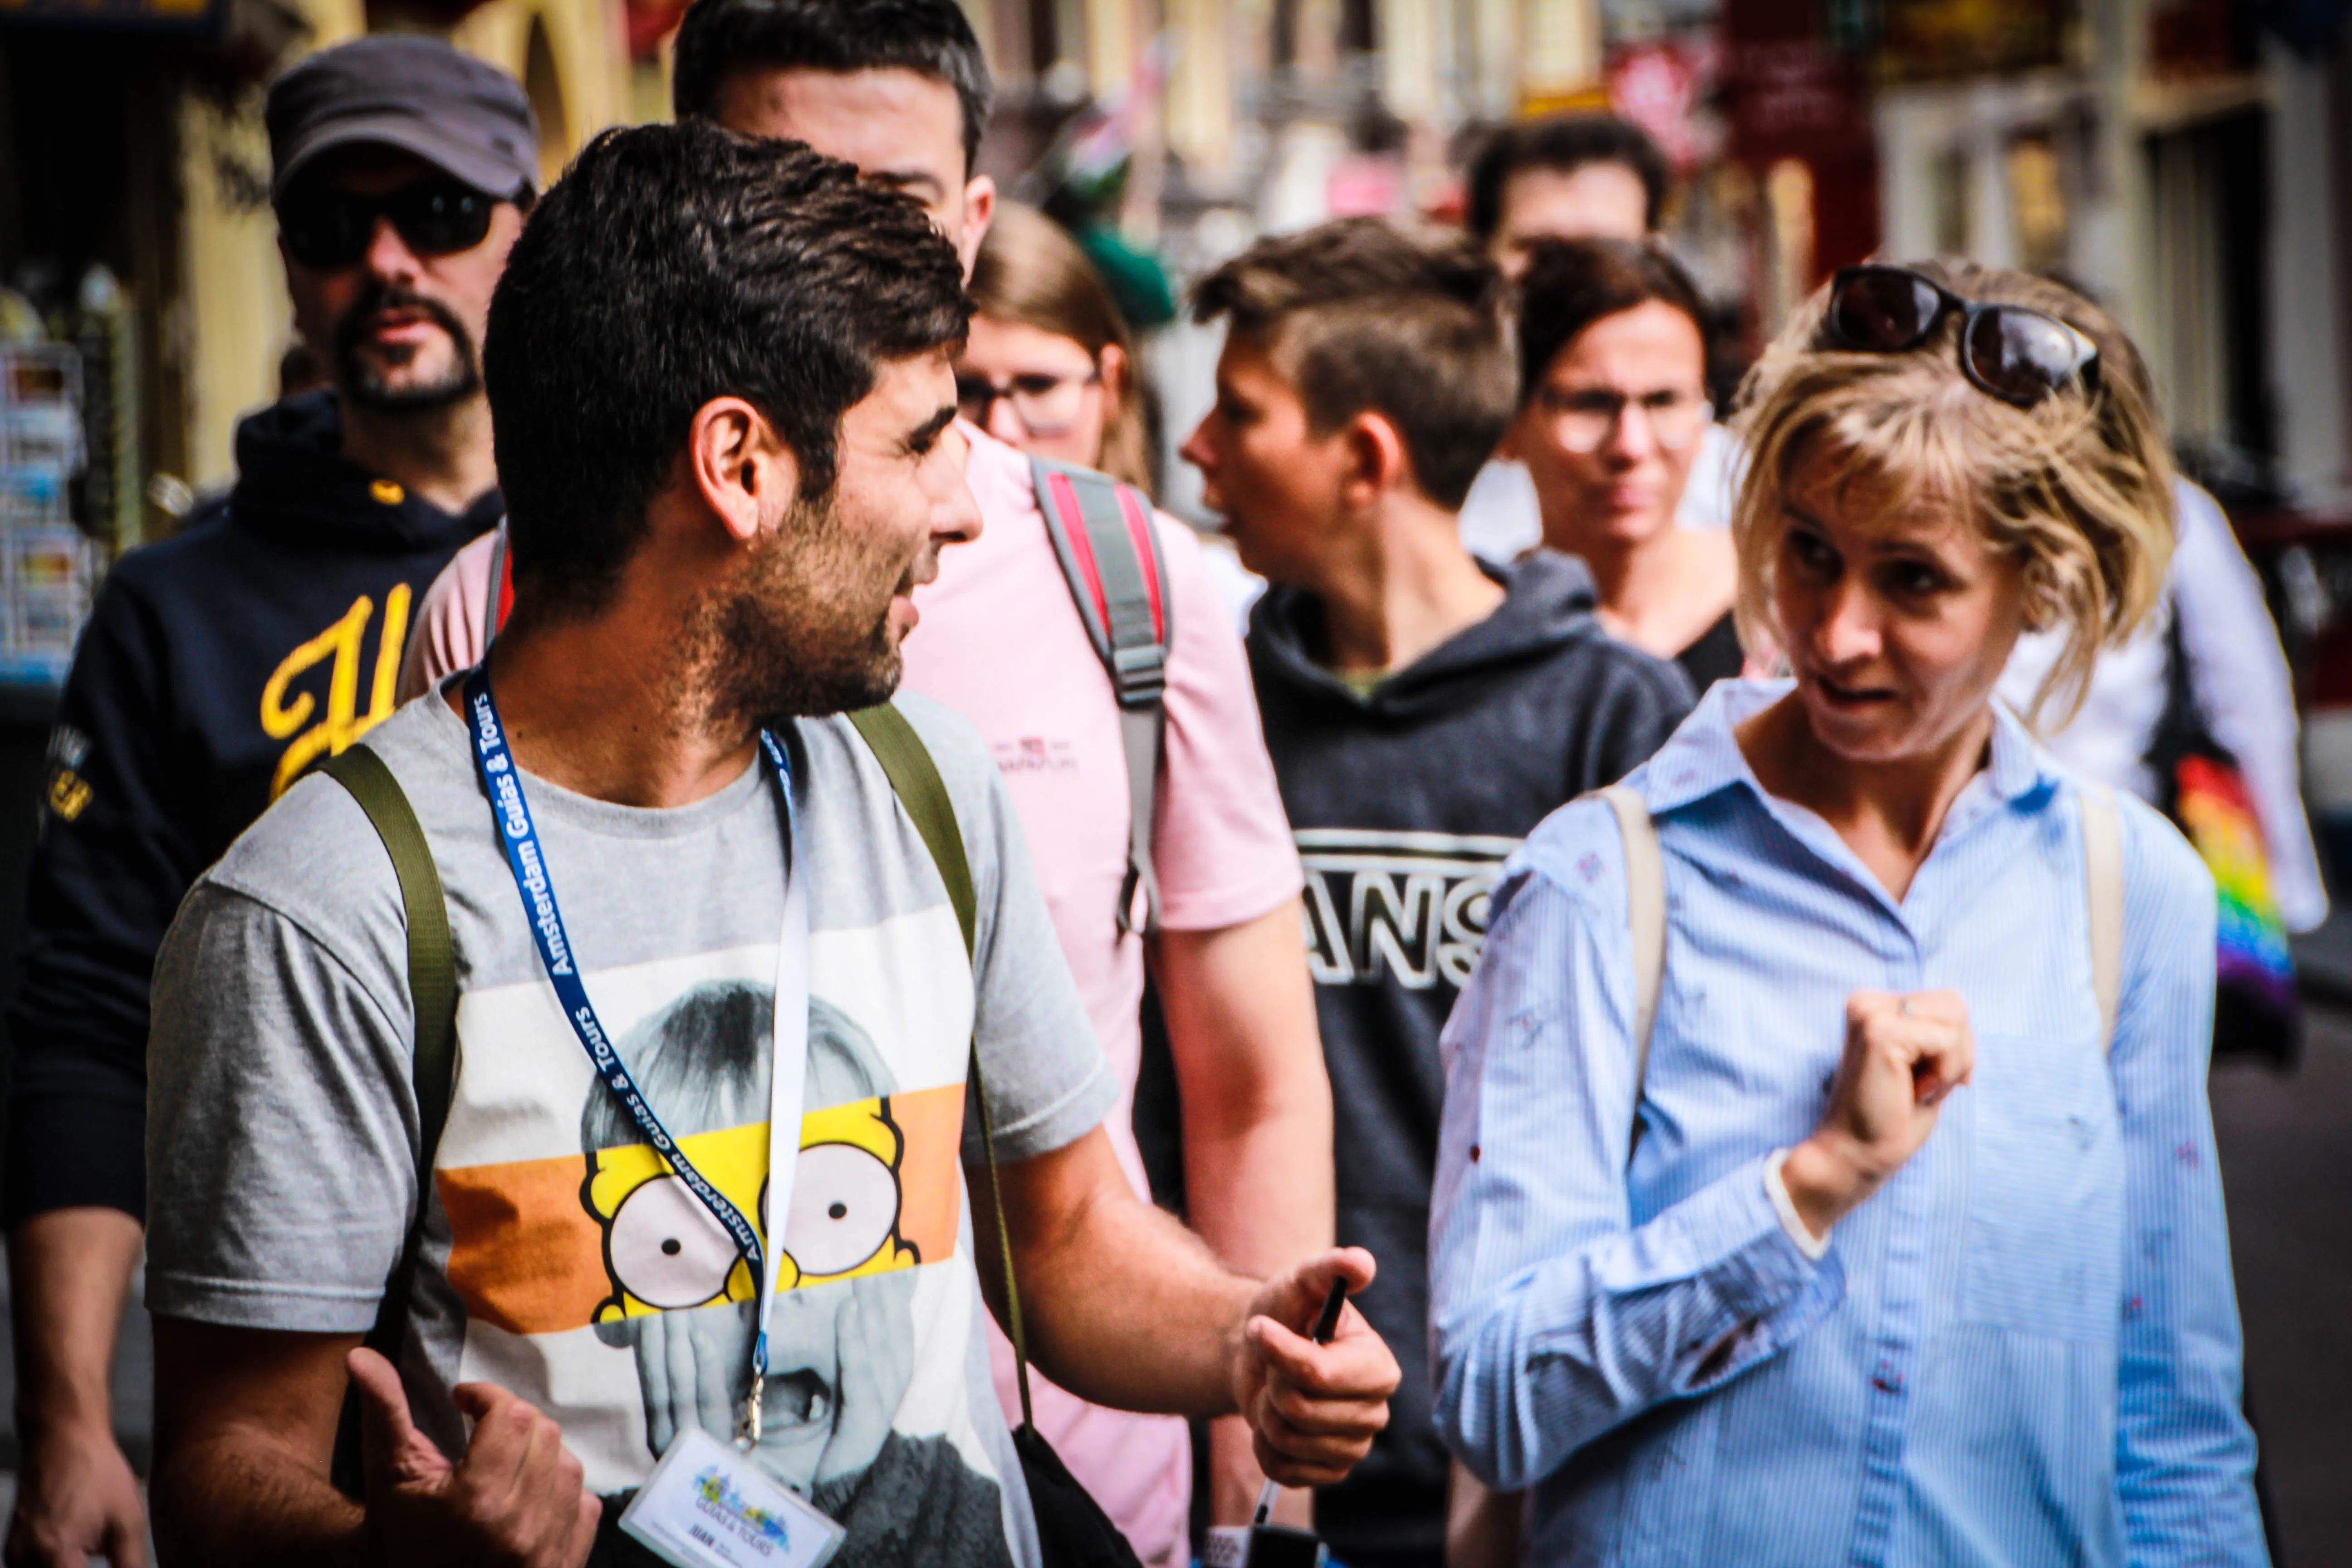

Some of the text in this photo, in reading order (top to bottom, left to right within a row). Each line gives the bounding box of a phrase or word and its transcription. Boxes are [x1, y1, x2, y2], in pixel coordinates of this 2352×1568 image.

[474, 691, 572, 976] Amsterdam Guias & Tours
[1299, 861, 1499, 989] ANS
[575, 1006, 759, 1262] Amsterdam Guias & Tours
